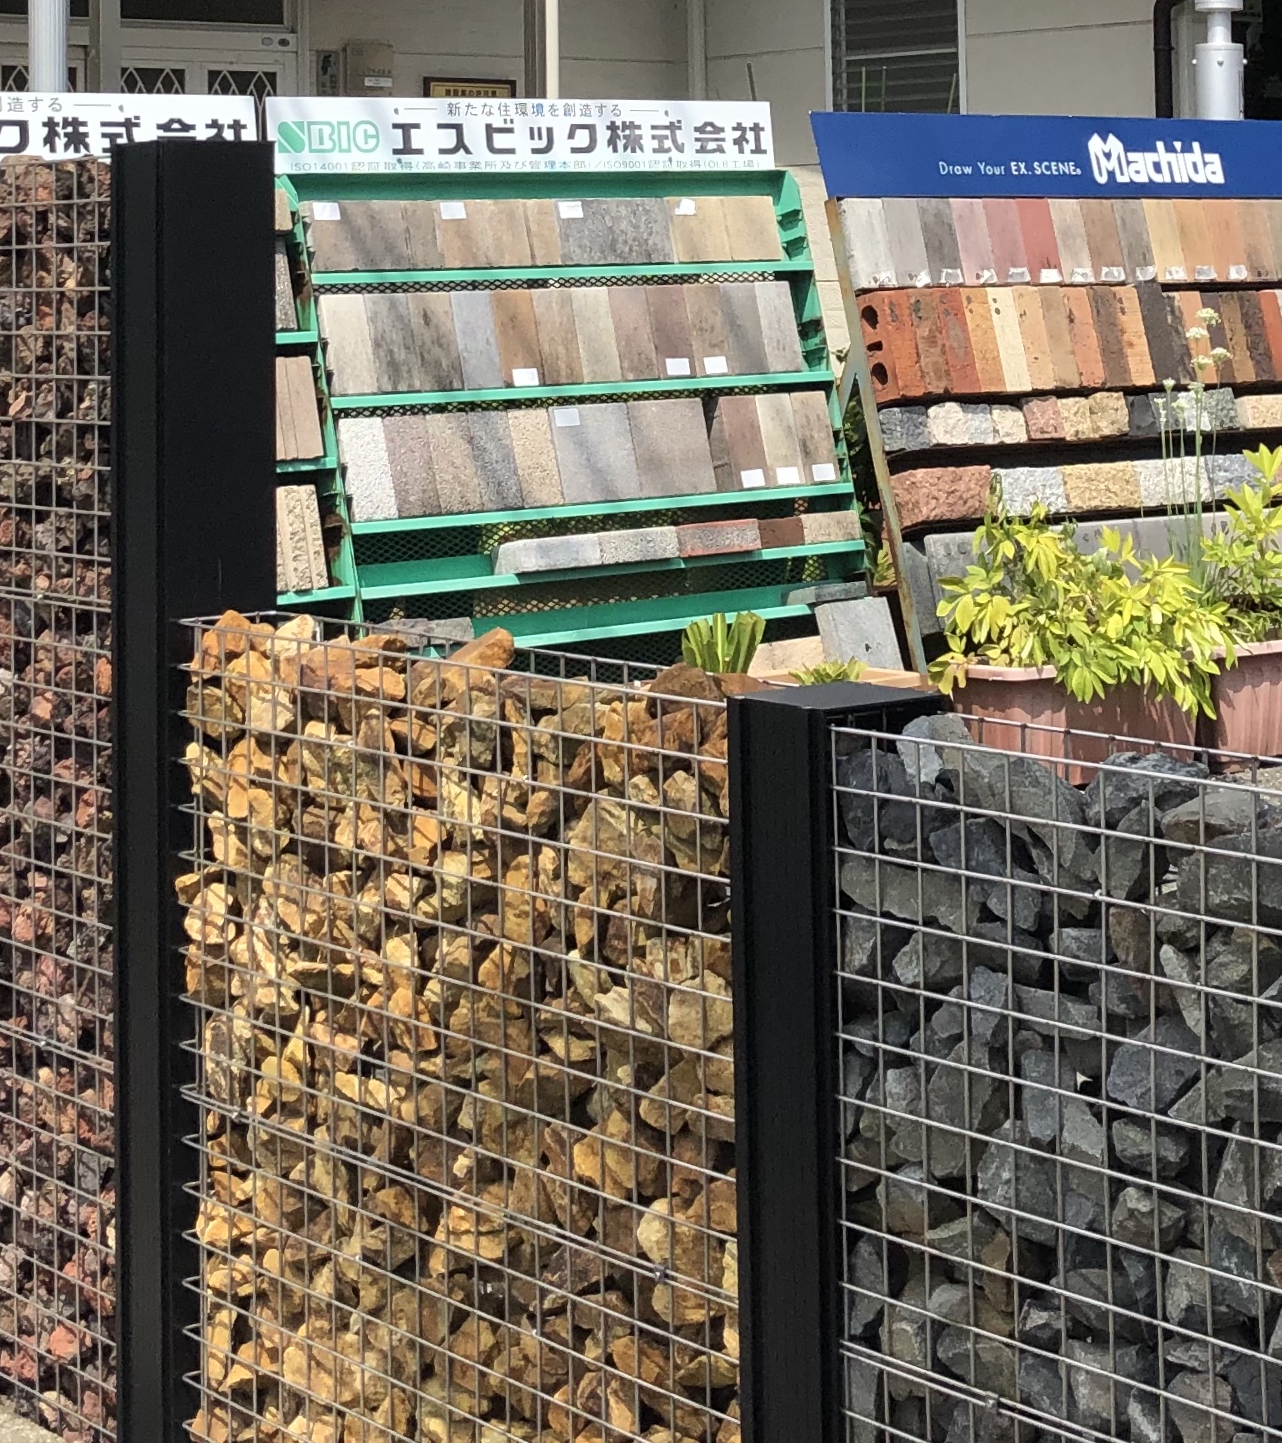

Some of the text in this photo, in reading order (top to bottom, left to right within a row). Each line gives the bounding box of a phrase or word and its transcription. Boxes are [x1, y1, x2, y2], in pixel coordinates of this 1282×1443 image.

[446, 101, 623, 118] 新たな住環境を創造する
[391, 118, 768, 155] エスビック株式会社
[938, 161, 973, 176] Draw
[977, 161, 1006, 176] Your
[1088, 132, 1226, 185] Machida
